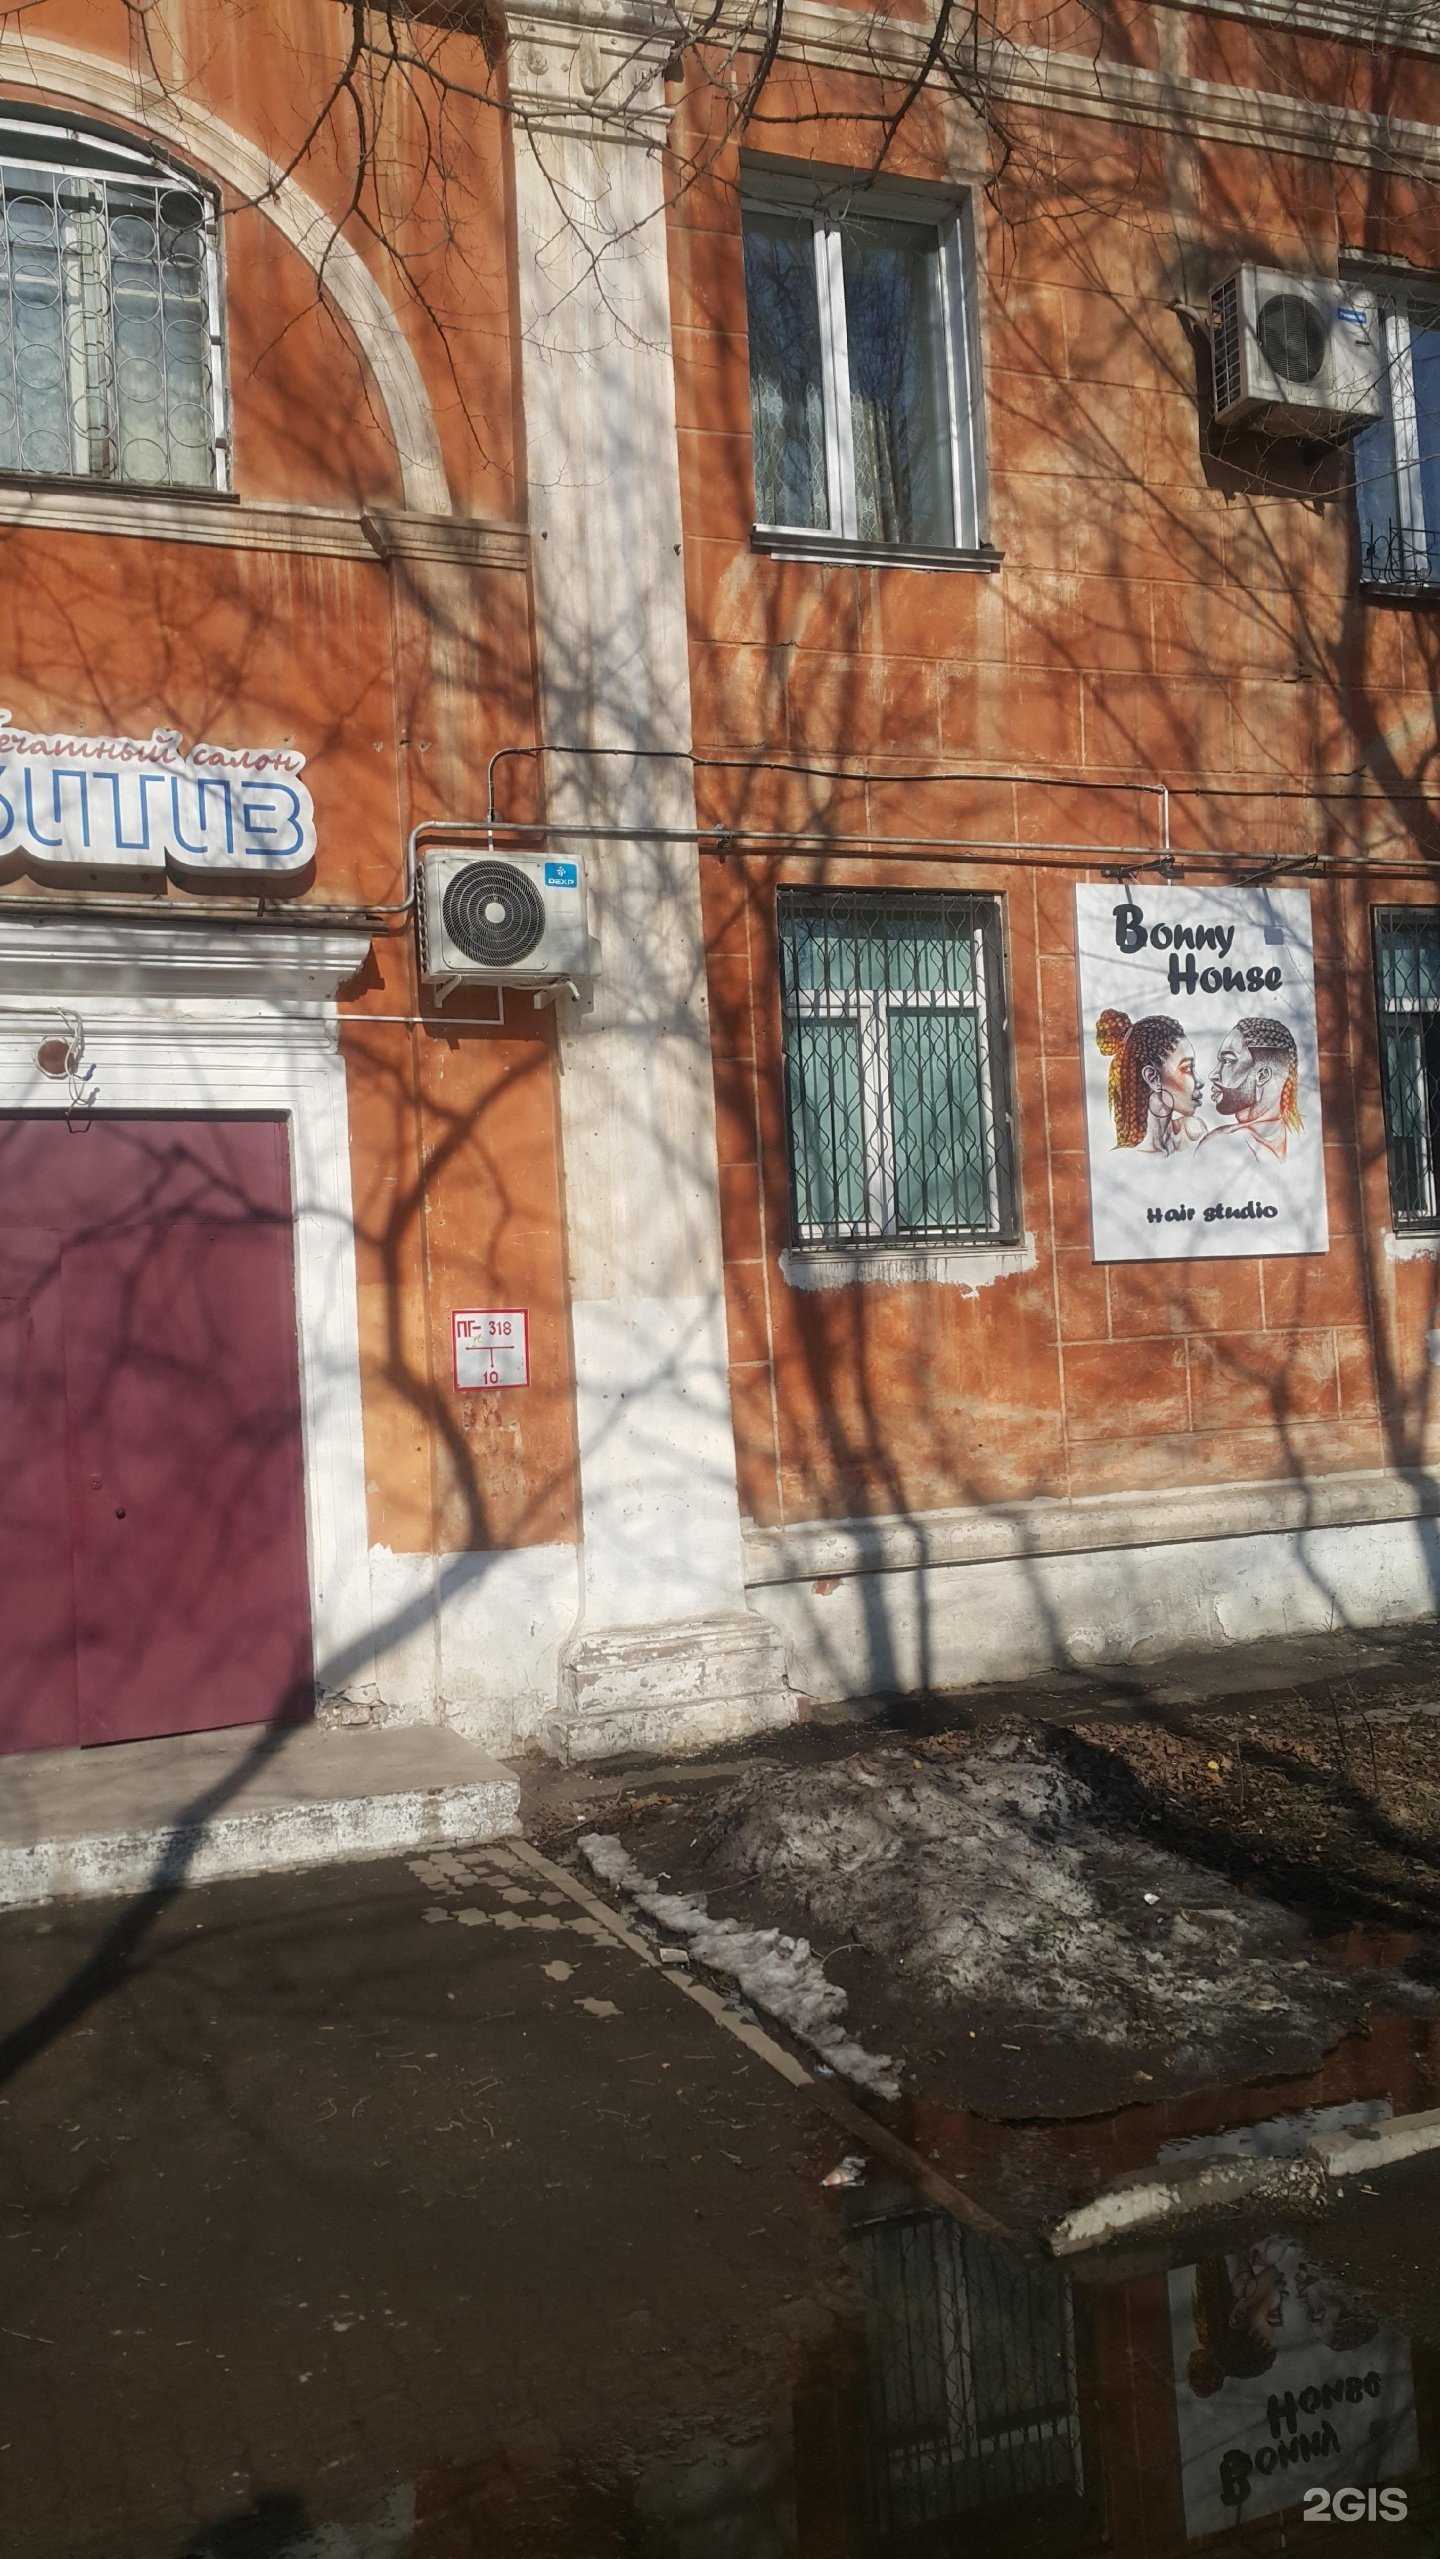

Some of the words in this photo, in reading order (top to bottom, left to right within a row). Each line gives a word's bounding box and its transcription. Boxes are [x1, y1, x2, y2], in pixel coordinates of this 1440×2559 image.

[0, 732, 176, 764] ечатный
[192, 747, 301, 772] салон
[0, 764, 304, 856] ИТИВ
[1112, 903, 1235, 958] Bonny
[1167, 953, 1283, 995] House
[1147, 1206, 1195, 1224] Hair
[1203, 1201, 1279, 1222] studio
[488, 1320, 512, 1336] 318
[483, 1370, 499, 1385] 10
